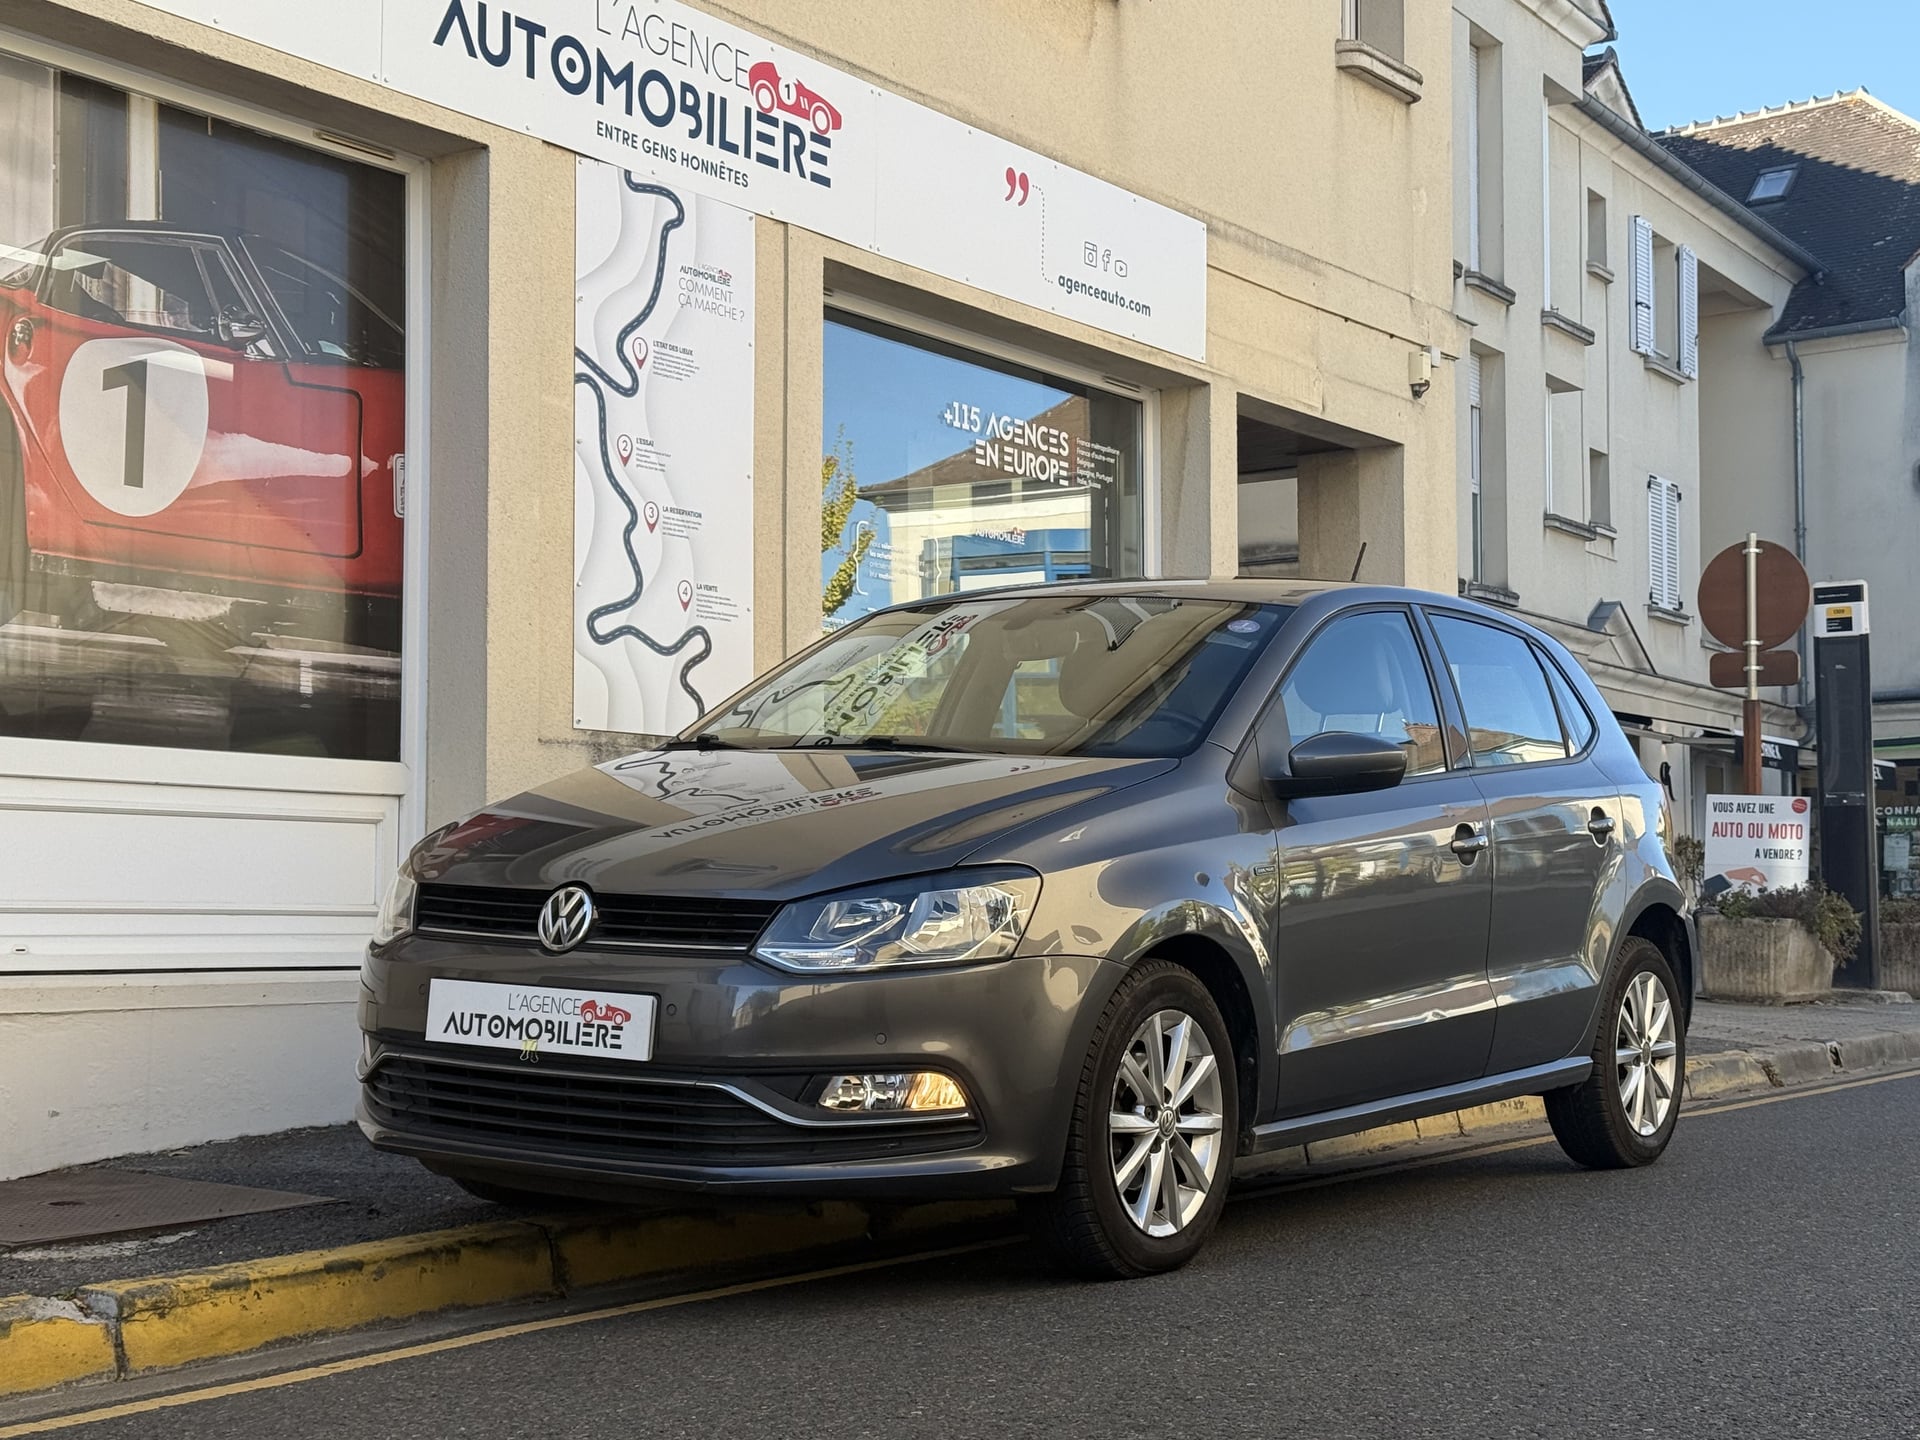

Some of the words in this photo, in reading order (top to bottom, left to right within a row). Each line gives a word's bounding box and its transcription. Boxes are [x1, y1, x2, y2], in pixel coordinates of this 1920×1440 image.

[596, 120, 638, 151] ENTRE
[642, 137, 677, 164] GENS
[681, 151, 750, 189] HONNÊTES
[679, 277, 734, 304] COMMENT
[1057, 273, 1152, 318] agenceauto.com
[678, 292, 693, 309] ÇA
[694, 297, 737, 321] MARCHE
[739, 309, 745, 322] ?
[637, 342, 642, 354] 1
[101, 358, 149, 490] 1
[943, 400, 981, 434] +115
[985, 411, 1070, 459] AGENCES
[622, 439, 629, 452] 2
[975, 438, 999, 469] EN
[1003, 446, 1069, 488] EUROPE
[648, 506, 655, 519] 3
[682, 586, 688, 597] 4
[1712, 801, 1734, 813] VOUS
[1735, 802, 1757, 814] AVEZ
[1758, 803, 1775, 815] UNE
[1711, 821, 1743, 839] AUTO
[1747, 822, 1764, 840] OU
[1768, 823, 1804, 841] MOTO
[1754, 848, 1761, 859] A
[1762, 848, 1795, 860] VENDRE
[1797, 849, 1803, 861] ?
[507, 992, 582, 1017] L'AGENCE
[443, 1011, 624, 1051] AUTOMOBILIERE
